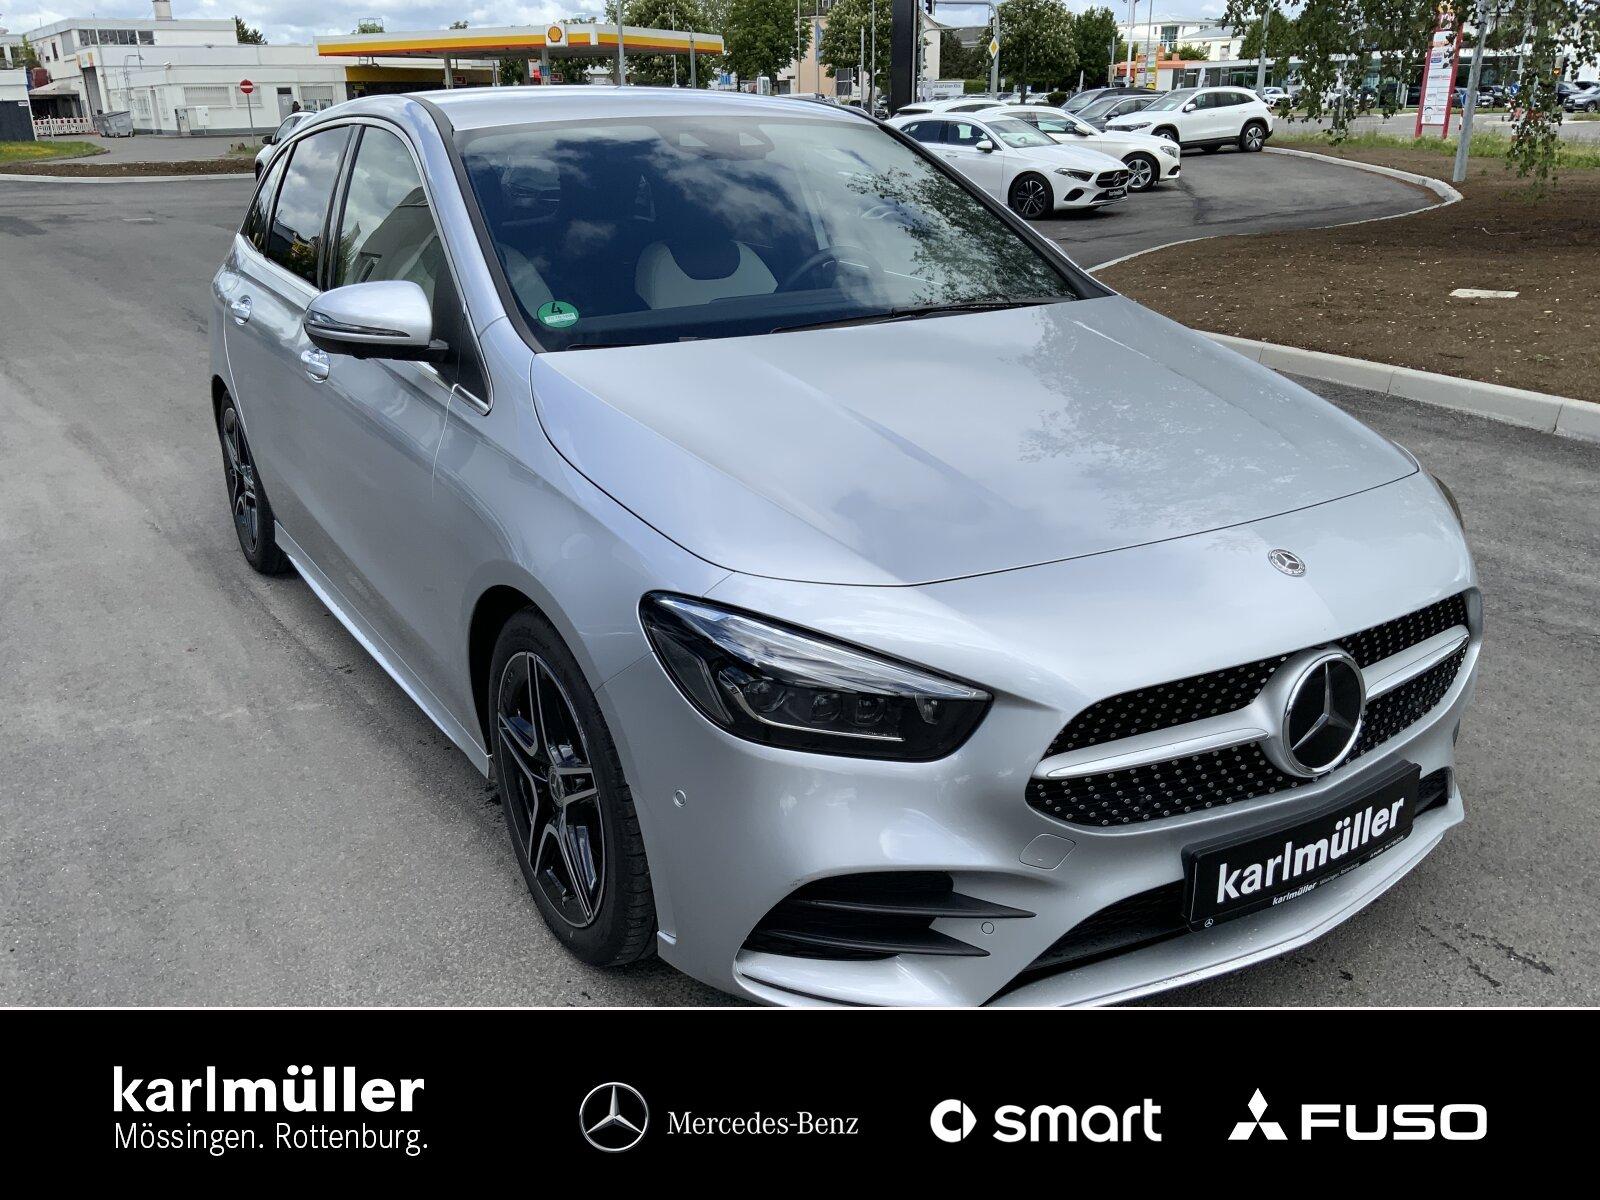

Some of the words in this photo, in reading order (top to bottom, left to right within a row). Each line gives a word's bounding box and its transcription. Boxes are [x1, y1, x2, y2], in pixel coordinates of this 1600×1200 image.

[551, 302, 563, 314] 4
[1216, 798, 1405, 904] karlmüller
[1272, 881, 1317, 906] karlmüller
